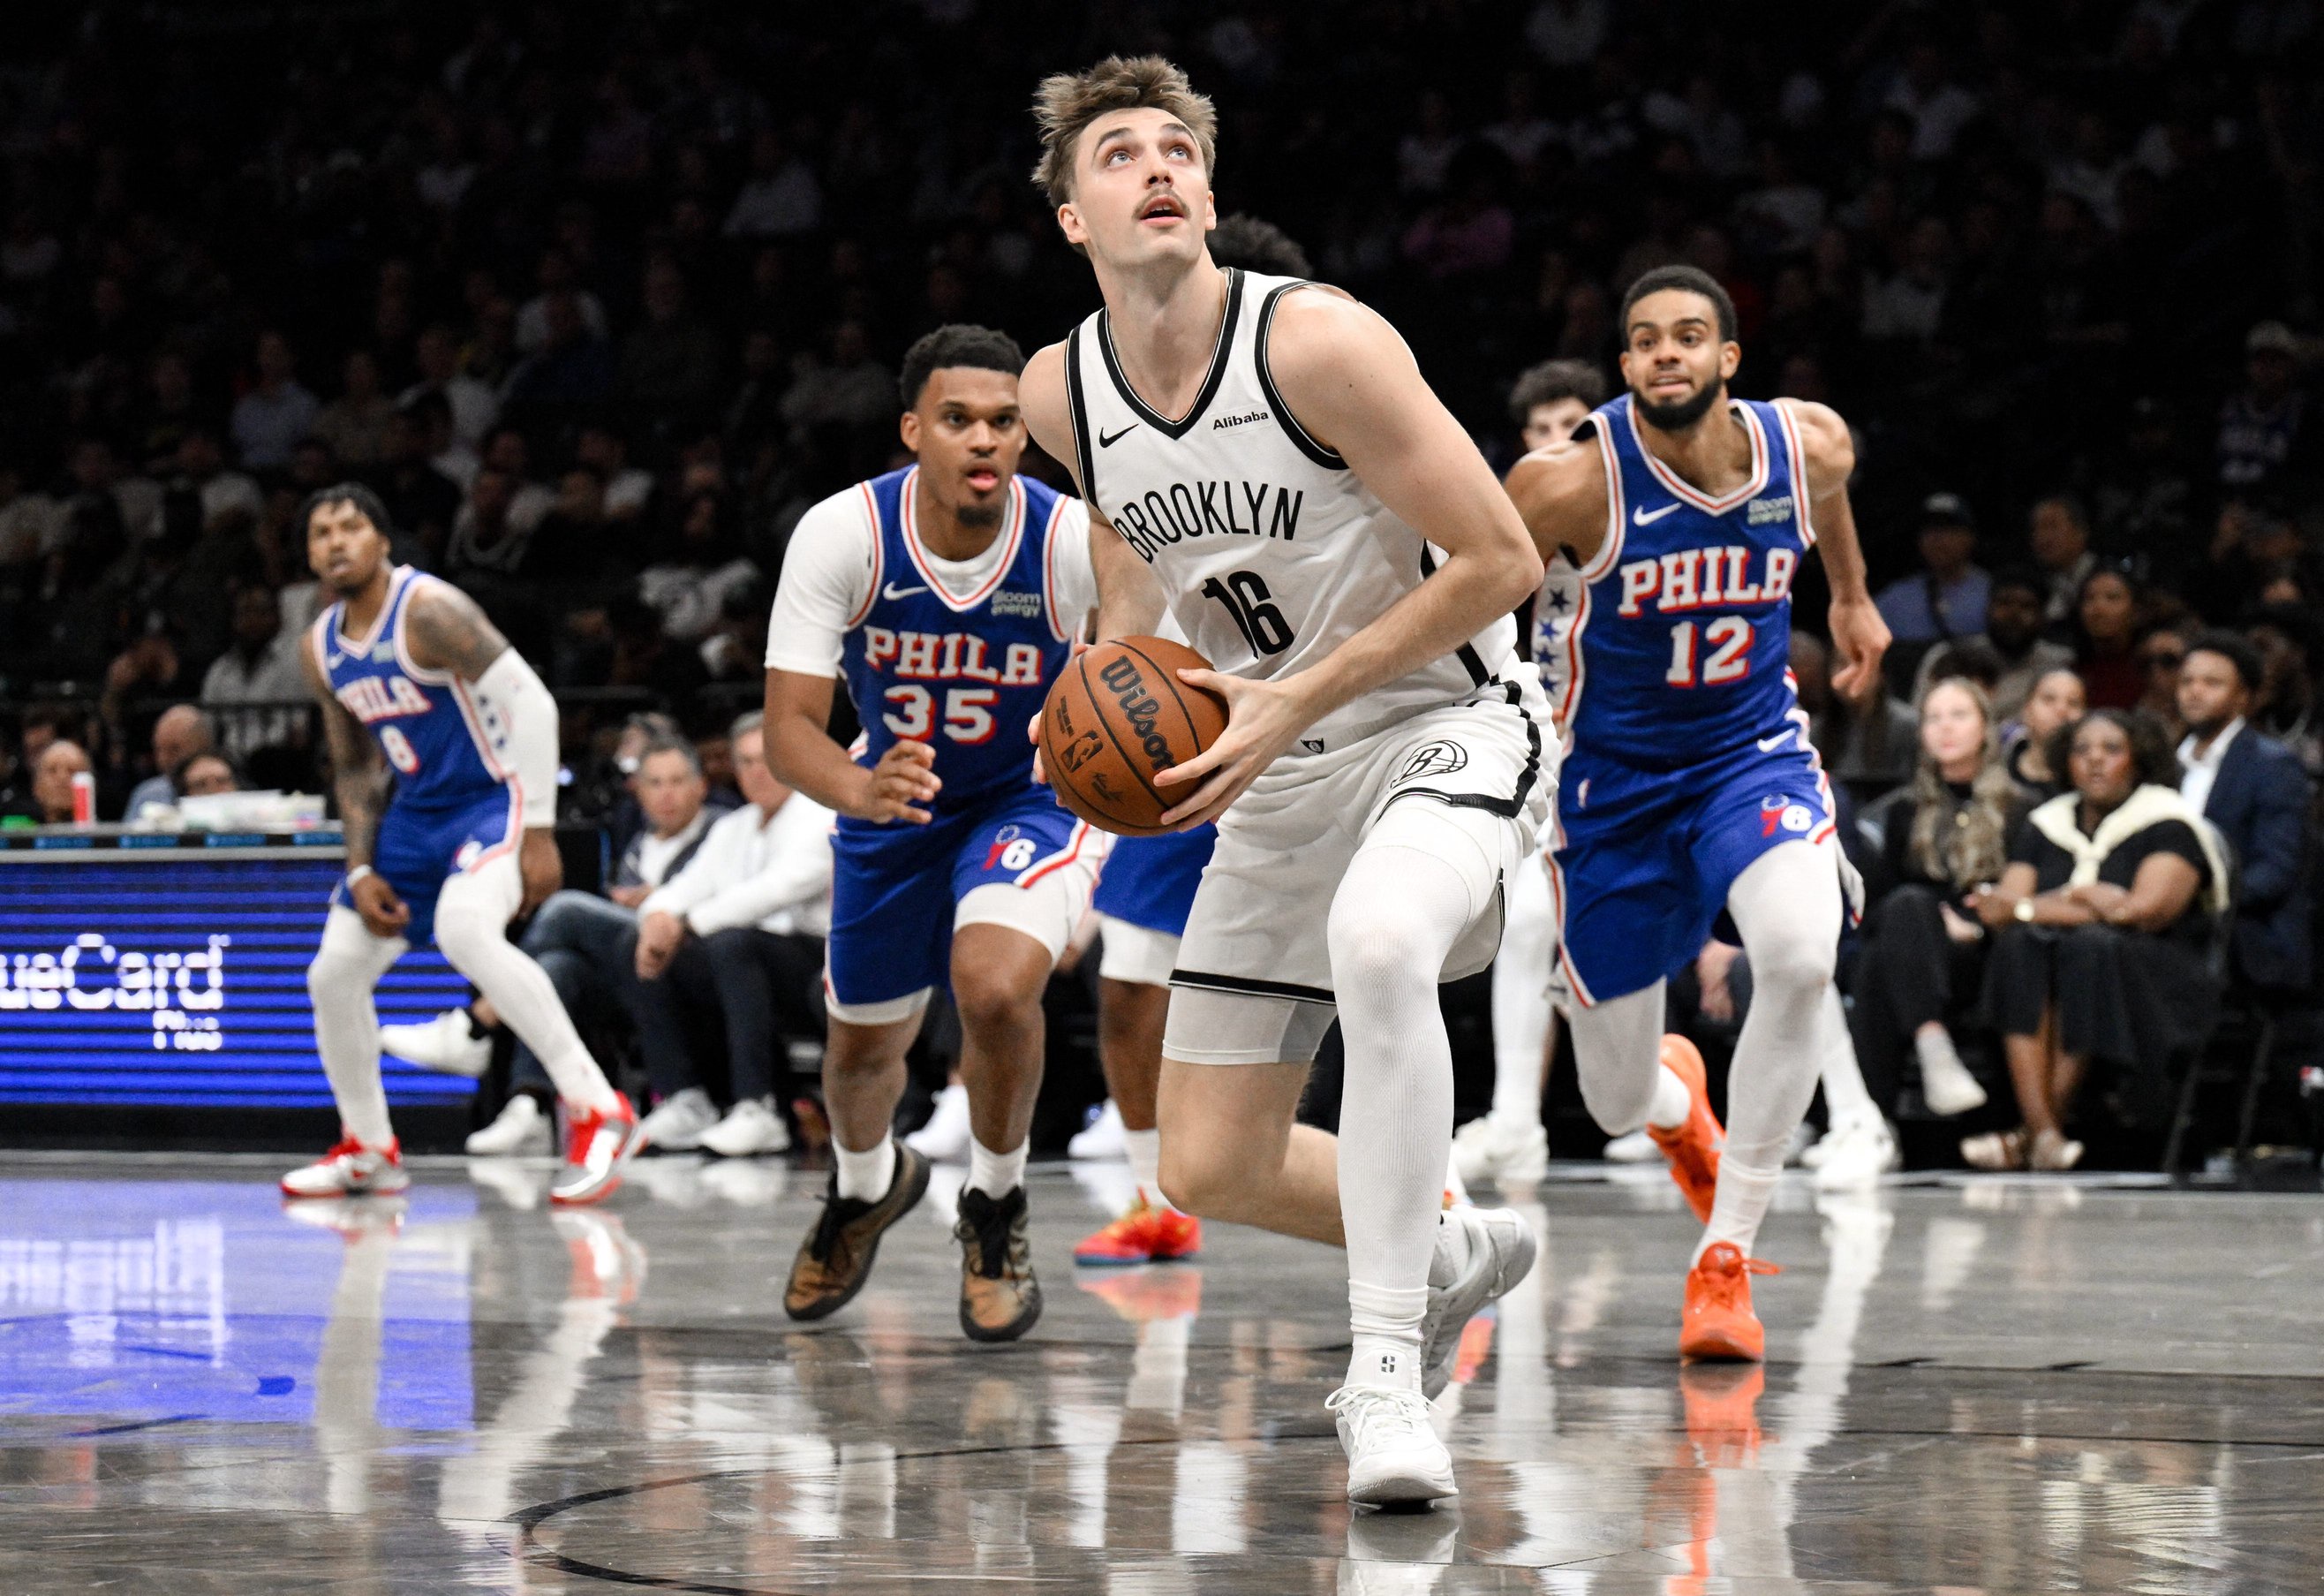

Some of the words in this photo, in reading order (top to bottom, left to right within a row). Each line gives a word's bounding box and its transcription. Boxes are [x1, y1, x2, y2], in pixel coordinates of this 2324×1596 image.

[1213, 412, 1269, 430] Alibaba
[1113, 481, 1303, 564] BROOKLYN
[1618, 546, 1797, 617] PHILA
[1201, 571, 1294, 660] 16
[864, 624, 1043, 686] PHILA
[1666, 615, 1754, 690] 12
[883, 684, 1000, 745] 35
[381, 725, 421, 775] 8
